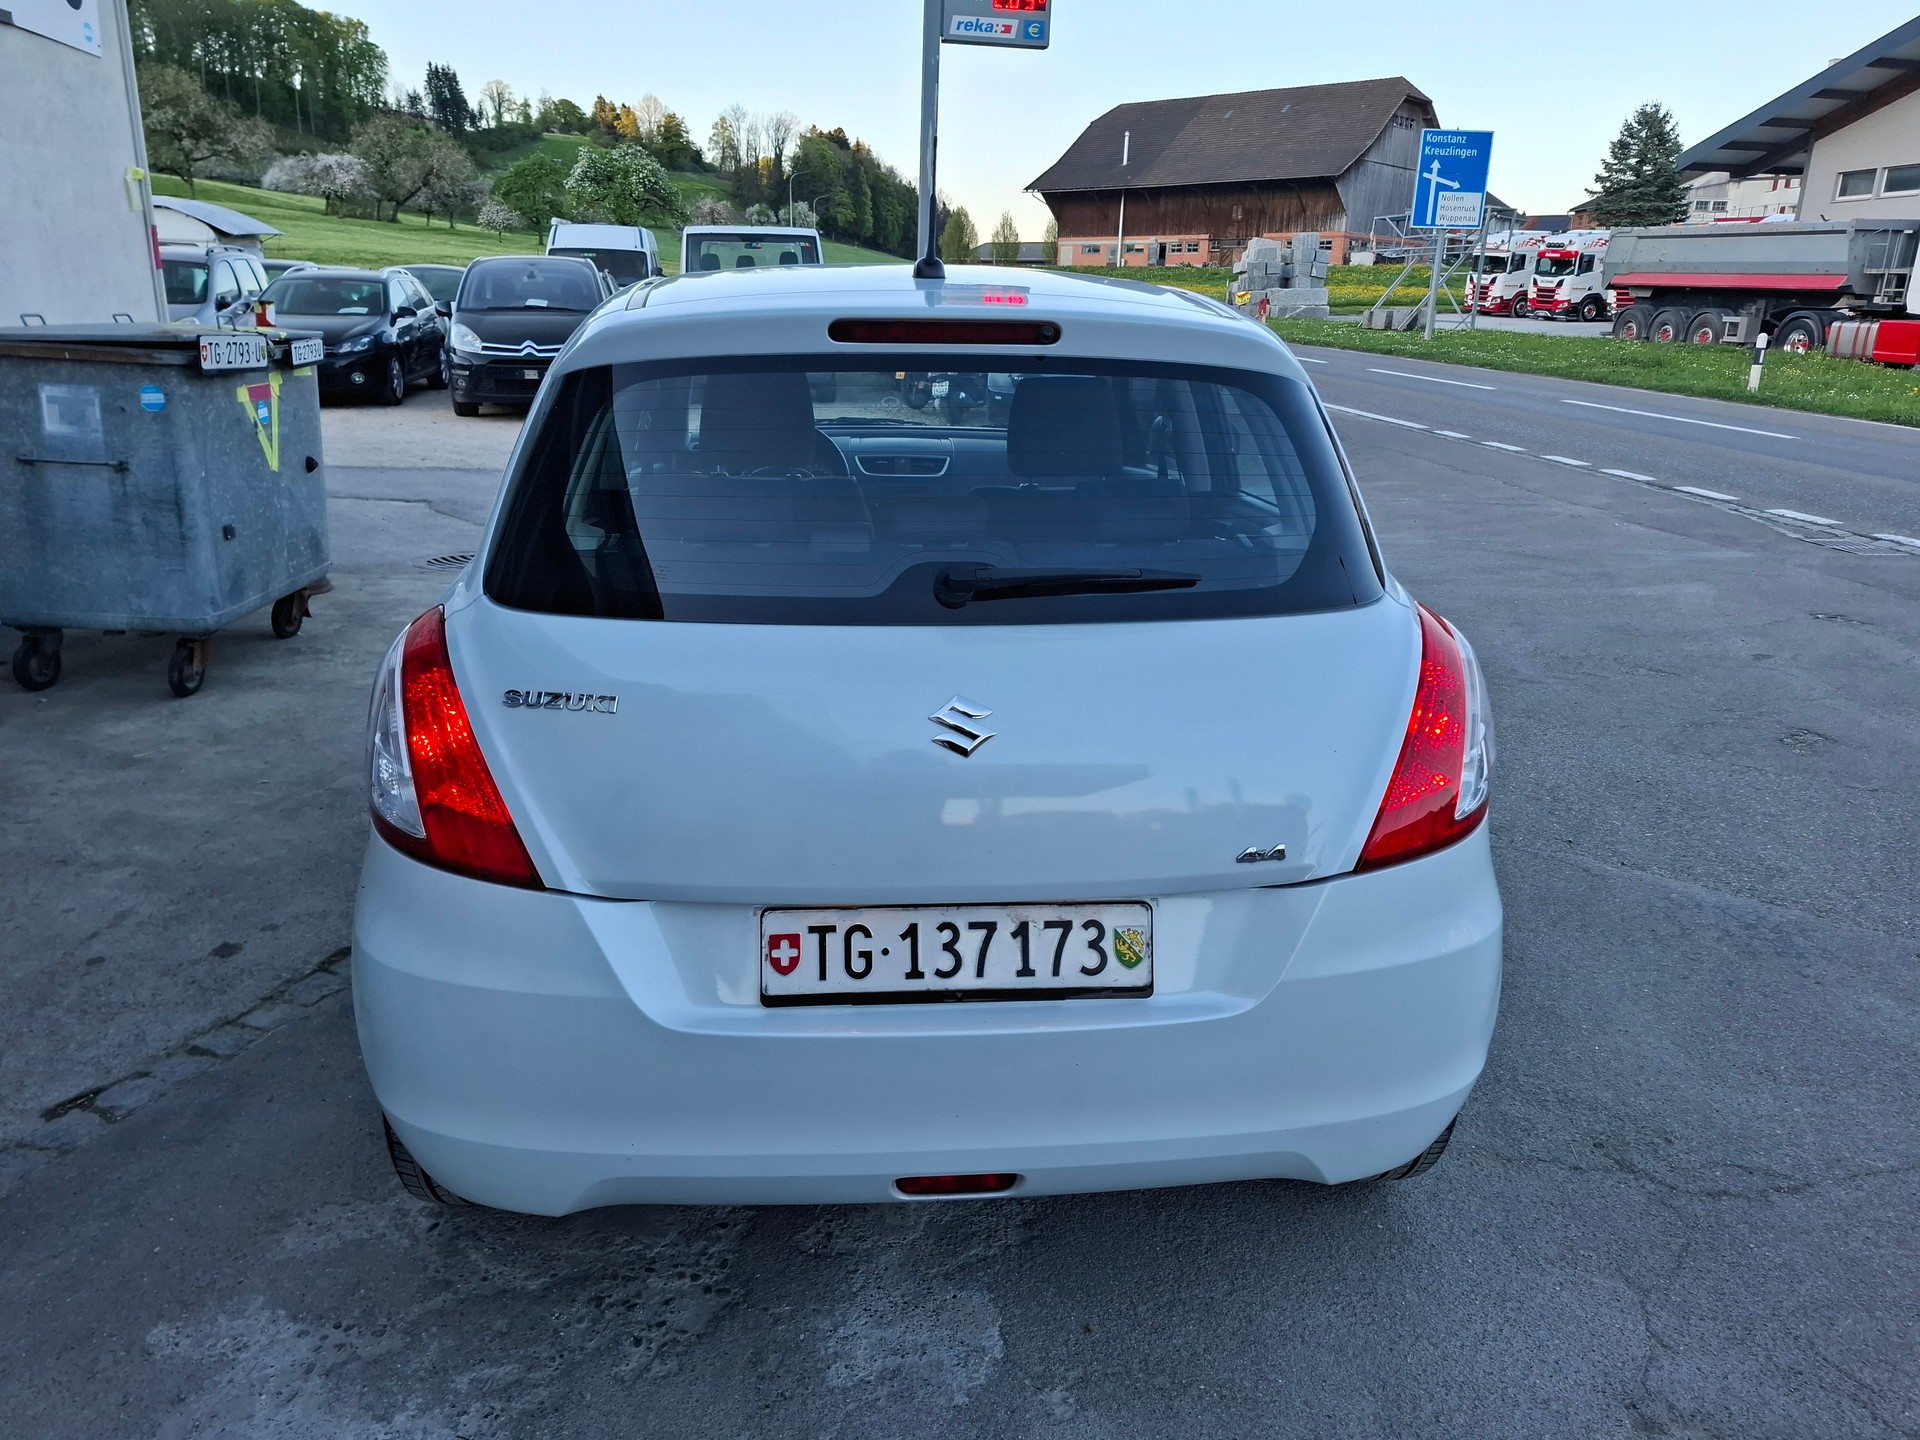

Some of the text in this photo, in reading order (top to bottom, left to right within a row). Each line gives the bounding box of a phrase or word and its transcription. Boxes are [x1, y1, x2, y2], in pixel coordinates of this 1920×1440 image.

[1426, 133, 1467, 144] Konstanz
[1424, 146, 1478, 158] Kreuzlingen
[1441, 194, 1464, 202] Nollen
[1440, 204, 1476, 212] Hosenruck
[1440, 214, 1476, 223] Wuppenau
[502, 688, 619, 714] SUZUKI
